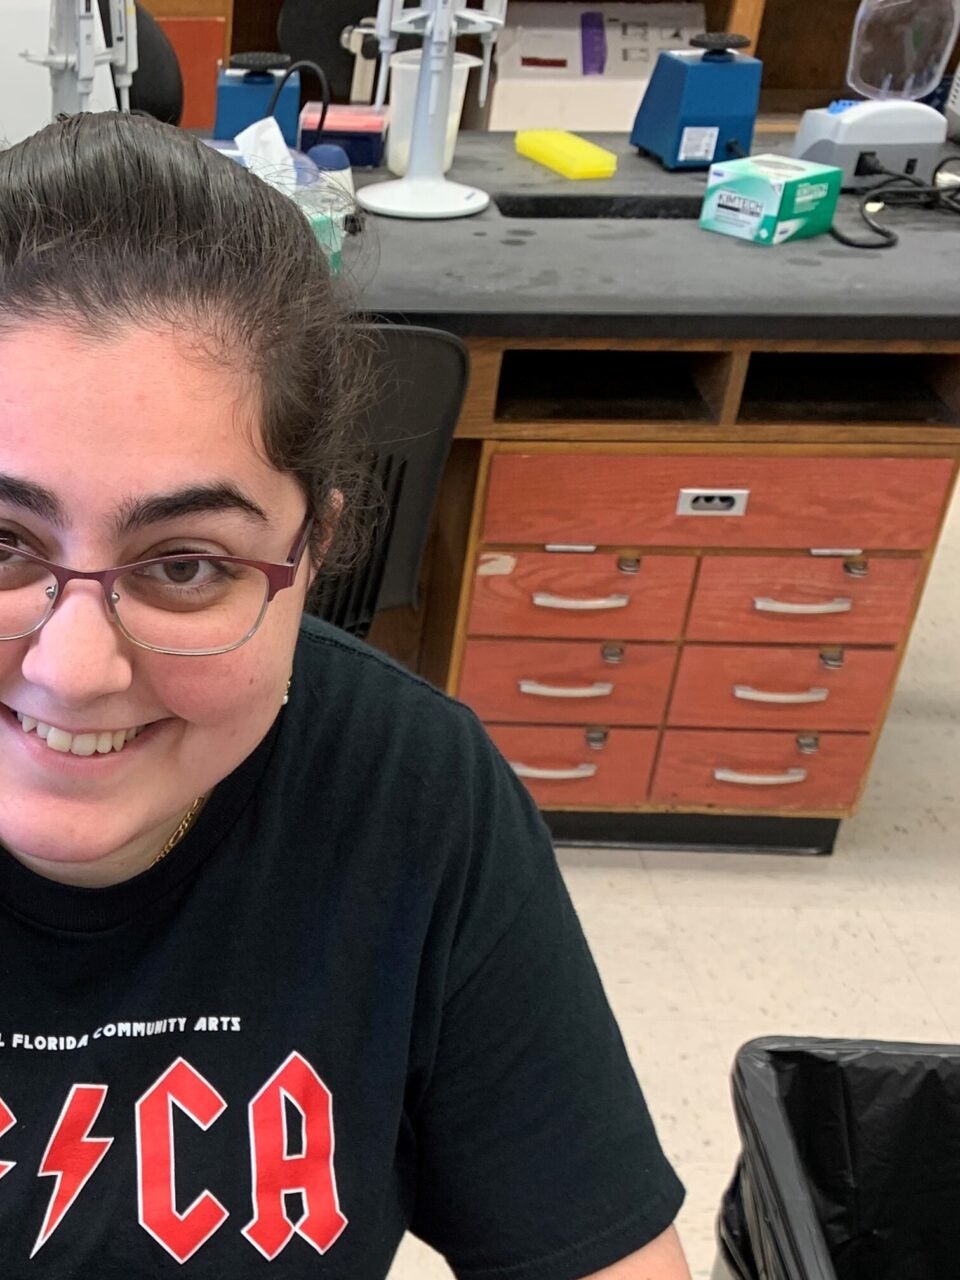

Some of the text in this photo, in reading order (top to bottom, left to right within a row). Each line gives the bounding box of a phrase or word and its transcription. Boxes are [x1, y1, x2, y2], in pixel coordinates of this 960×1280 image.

[718, 192, 764, 212] KIMTECH
[12, 1034, 89, 1051] FLORIDA
[93, 1017, 187, 1040] COMMUNITY
[194, 1016, 241, 1032] ARTS
